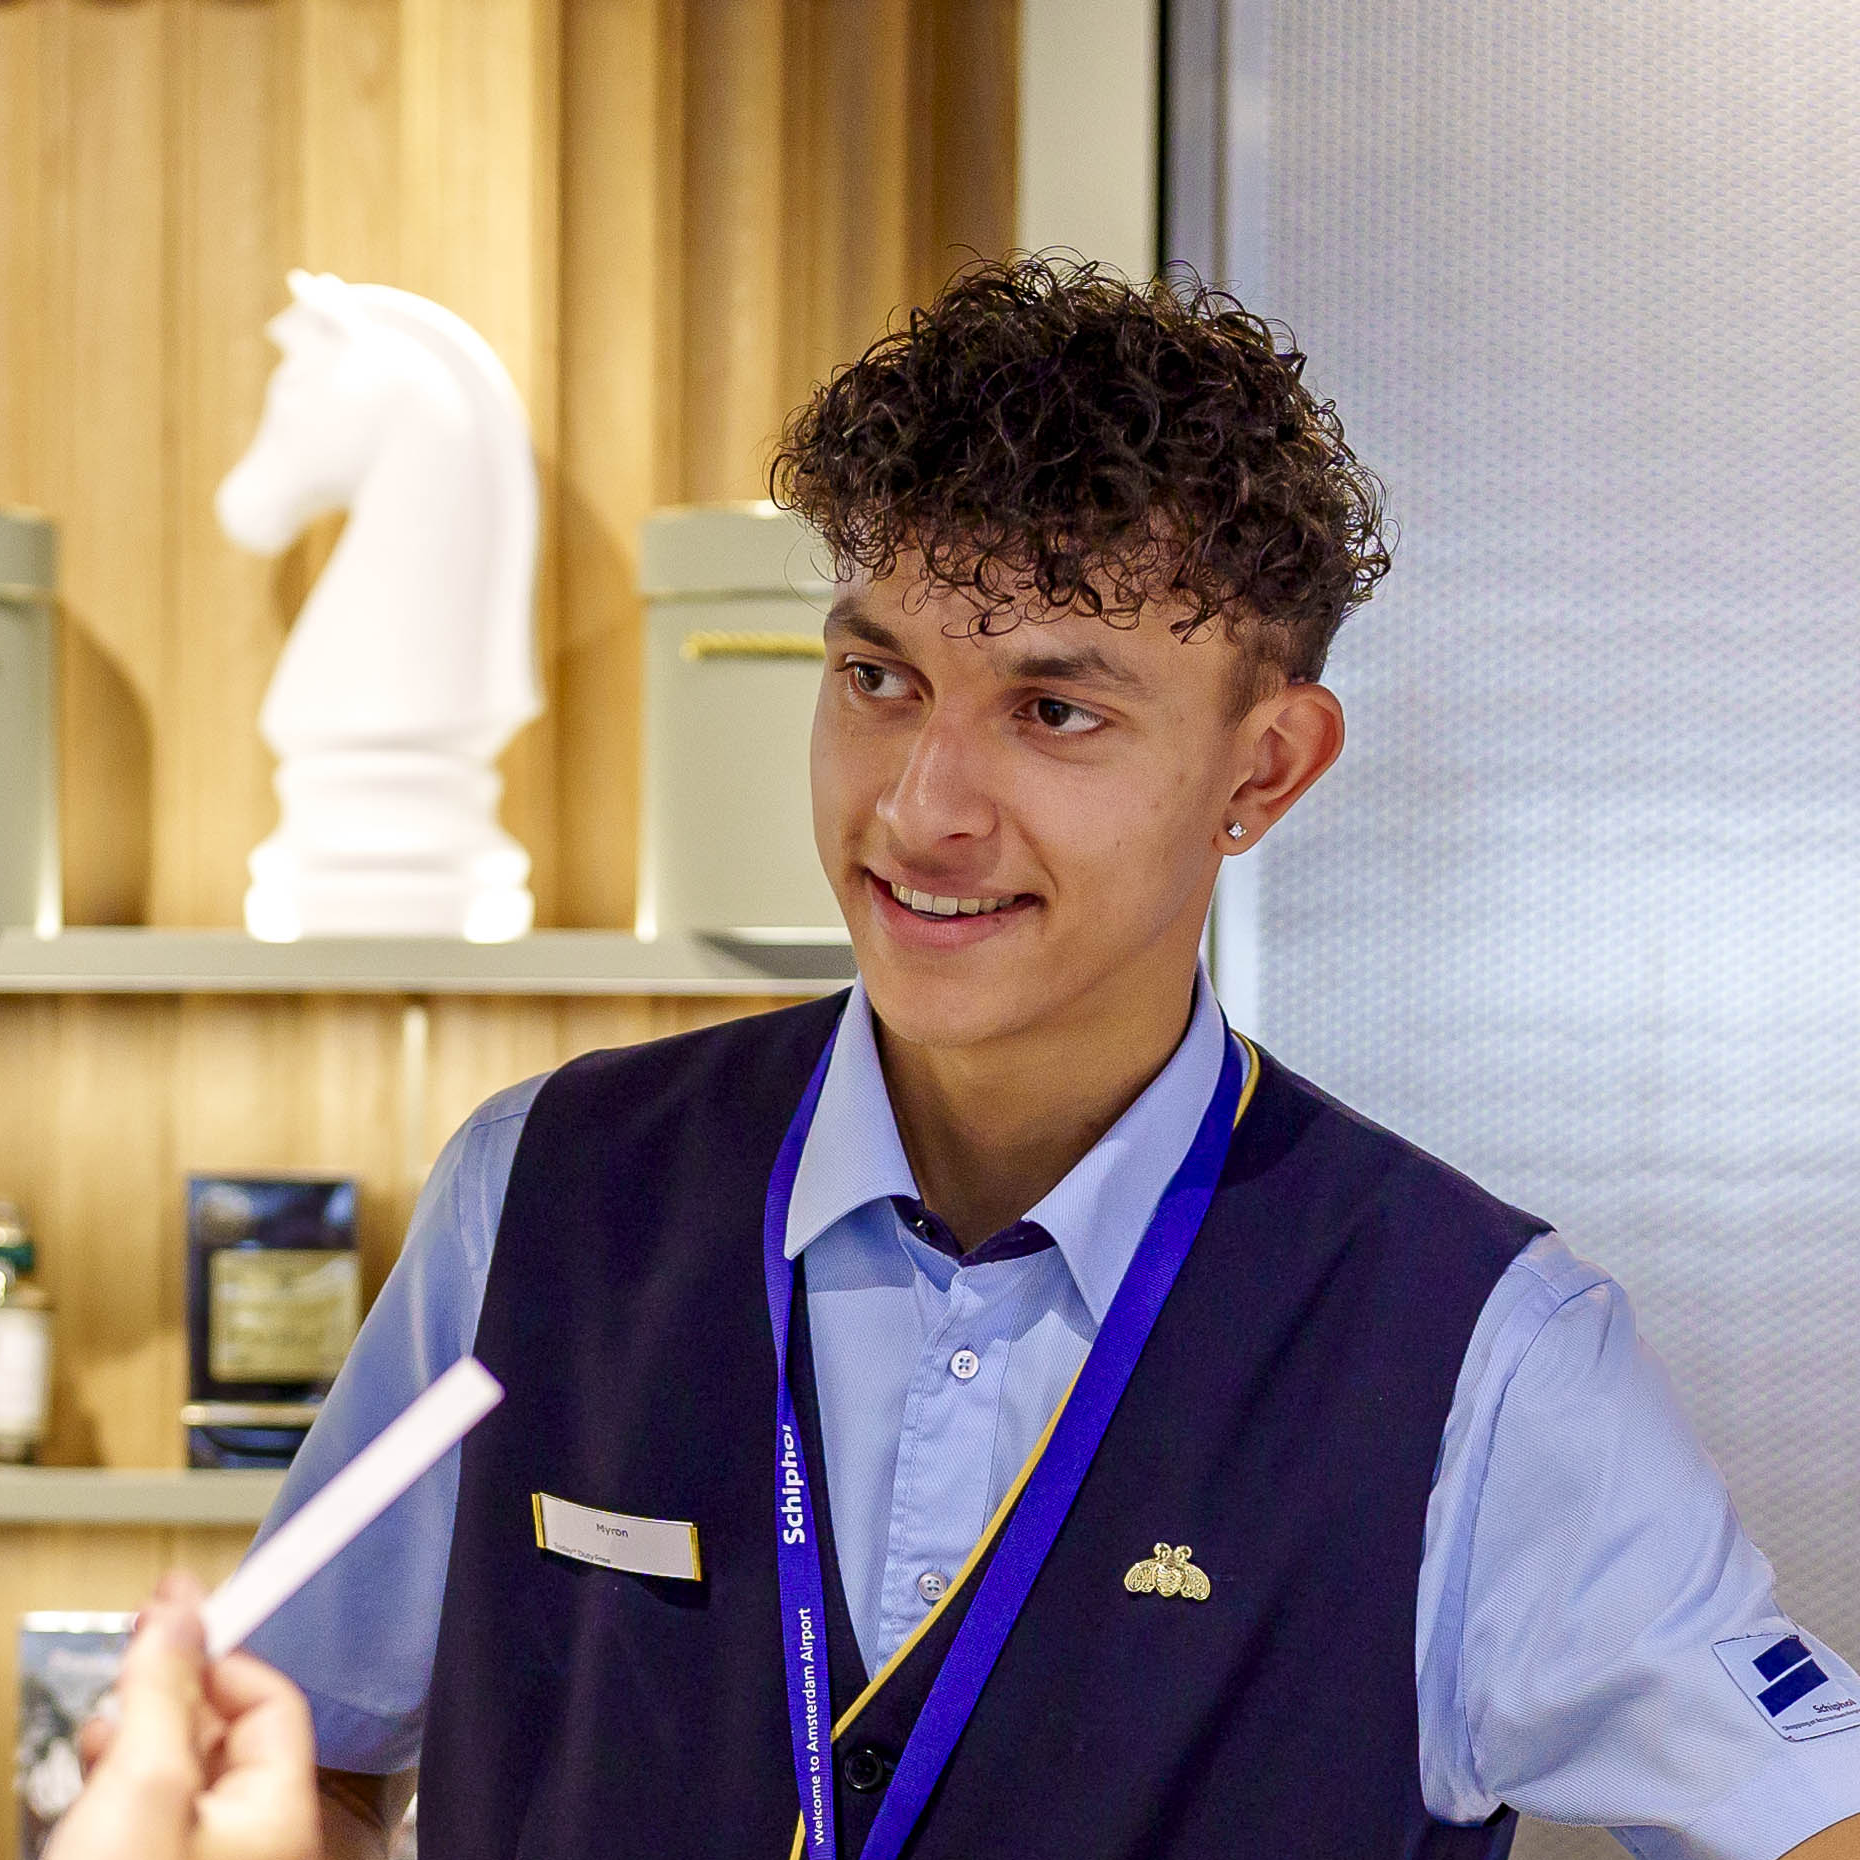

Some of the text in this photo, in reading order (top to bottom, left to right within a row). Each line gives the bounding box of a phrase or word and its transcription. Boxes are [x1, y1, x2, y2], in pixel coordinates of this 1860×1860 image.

[596, 1523, 628, 1538] Myron
[1812, 1698, 1857, 1713] Schiphol
[798, 1607, 824, 1846] Welcome to Amsterdam Airport
